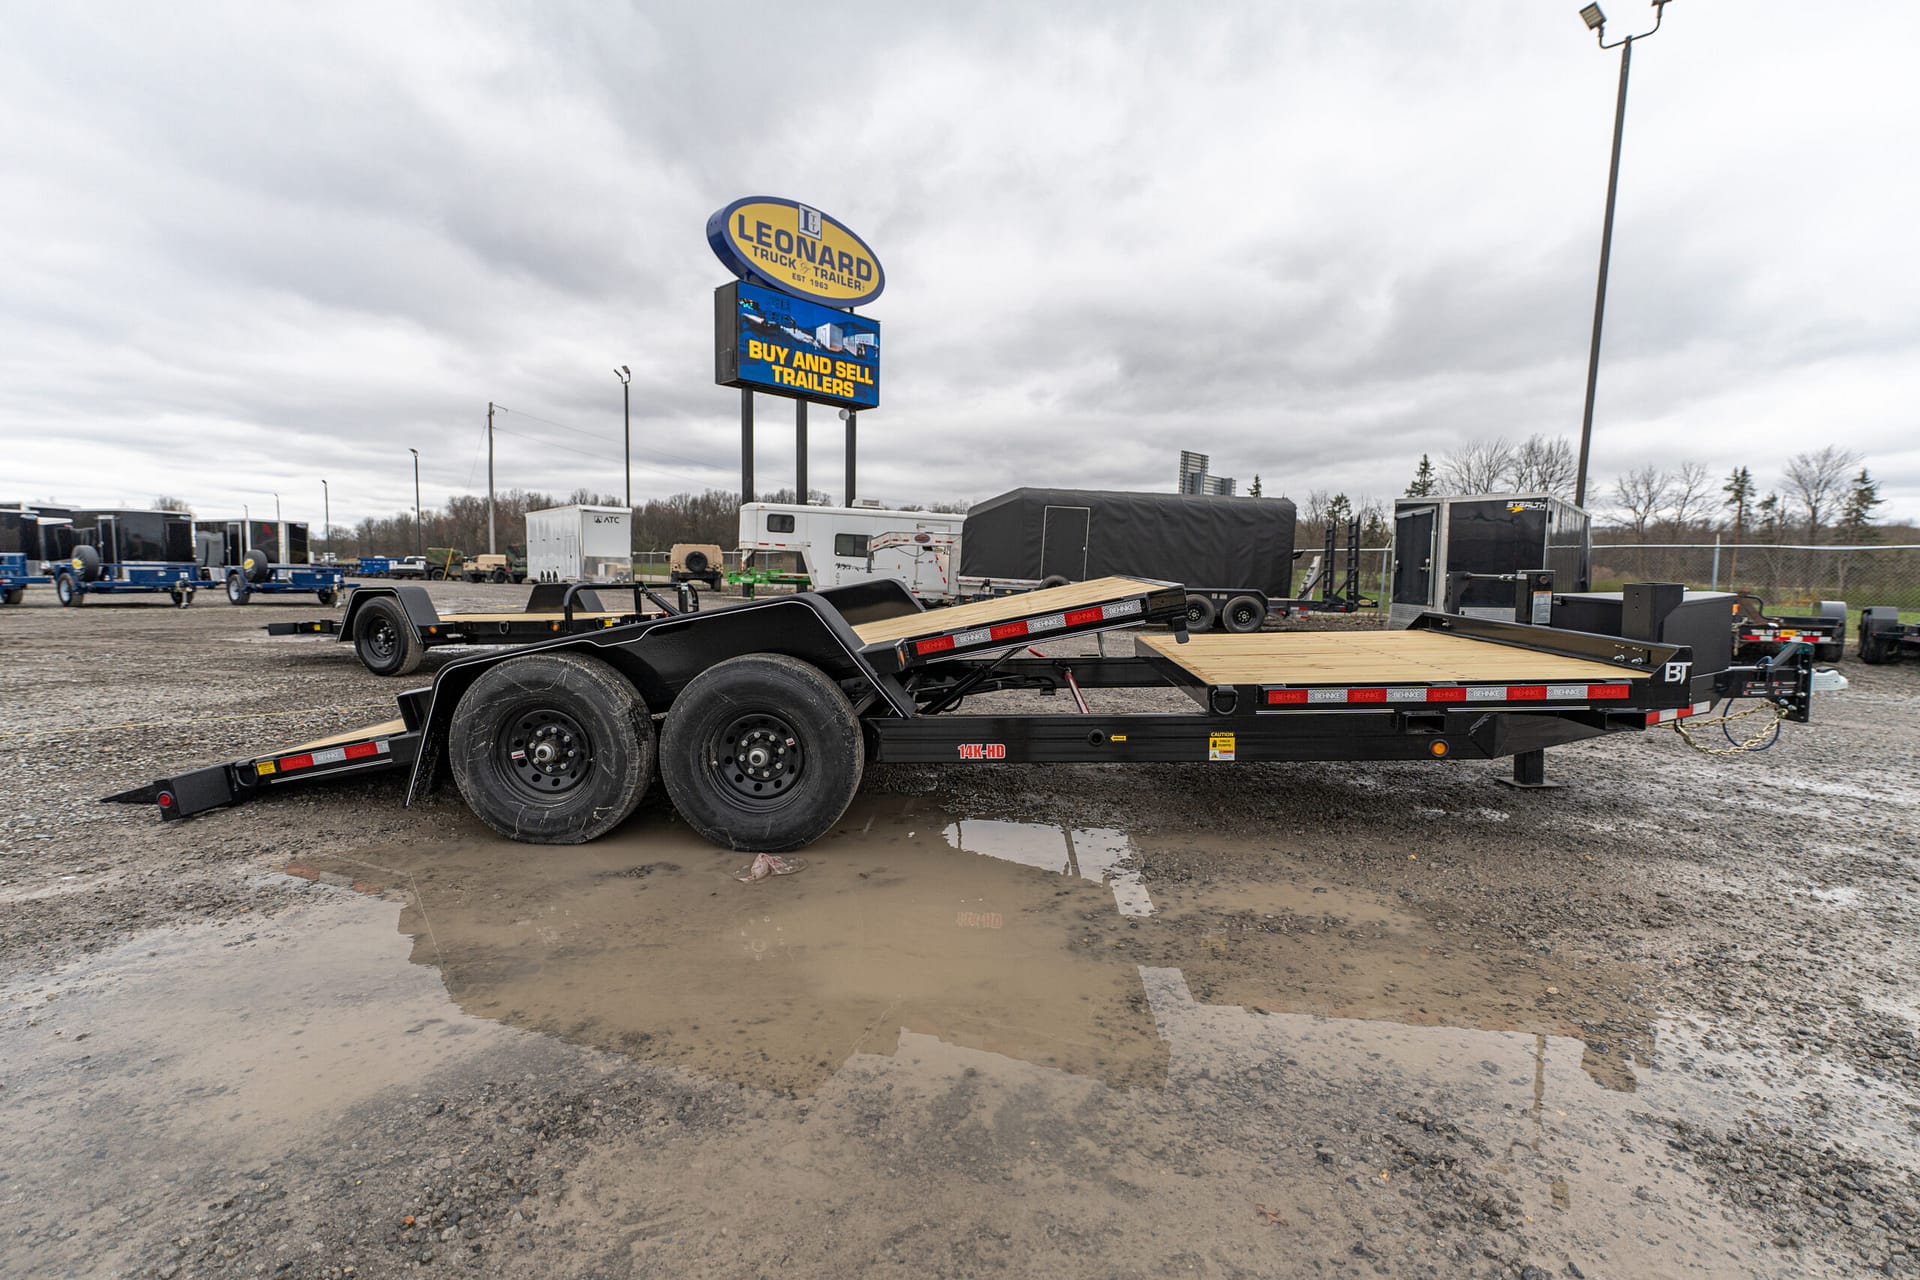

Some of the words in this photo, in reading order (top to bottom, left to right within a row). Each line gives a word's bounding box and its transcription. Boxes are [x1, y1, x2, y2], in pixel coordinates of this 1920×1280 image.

[738, 214, 872, 282] LEONARD
[752, 245, 797, 270] TRUCK
[813, 266, 861, 292] TRAILER
[792, 273, 806, 283] EST
[810, 279, 828, 290] 1963
[749, 340, 788, 364] BUY
[793, 351, 831, 374] AND
[836, 362, 873, 384] SELL
[772, 365, 854, 397] TRAILERS
[1033, 618, 1058, 628] BEHNKE
[1109, 604, 1134, 614] BEHNKE
[1665, 662, 1692, 684] BT
[958, 744, 1005, 759] 14K-HD
